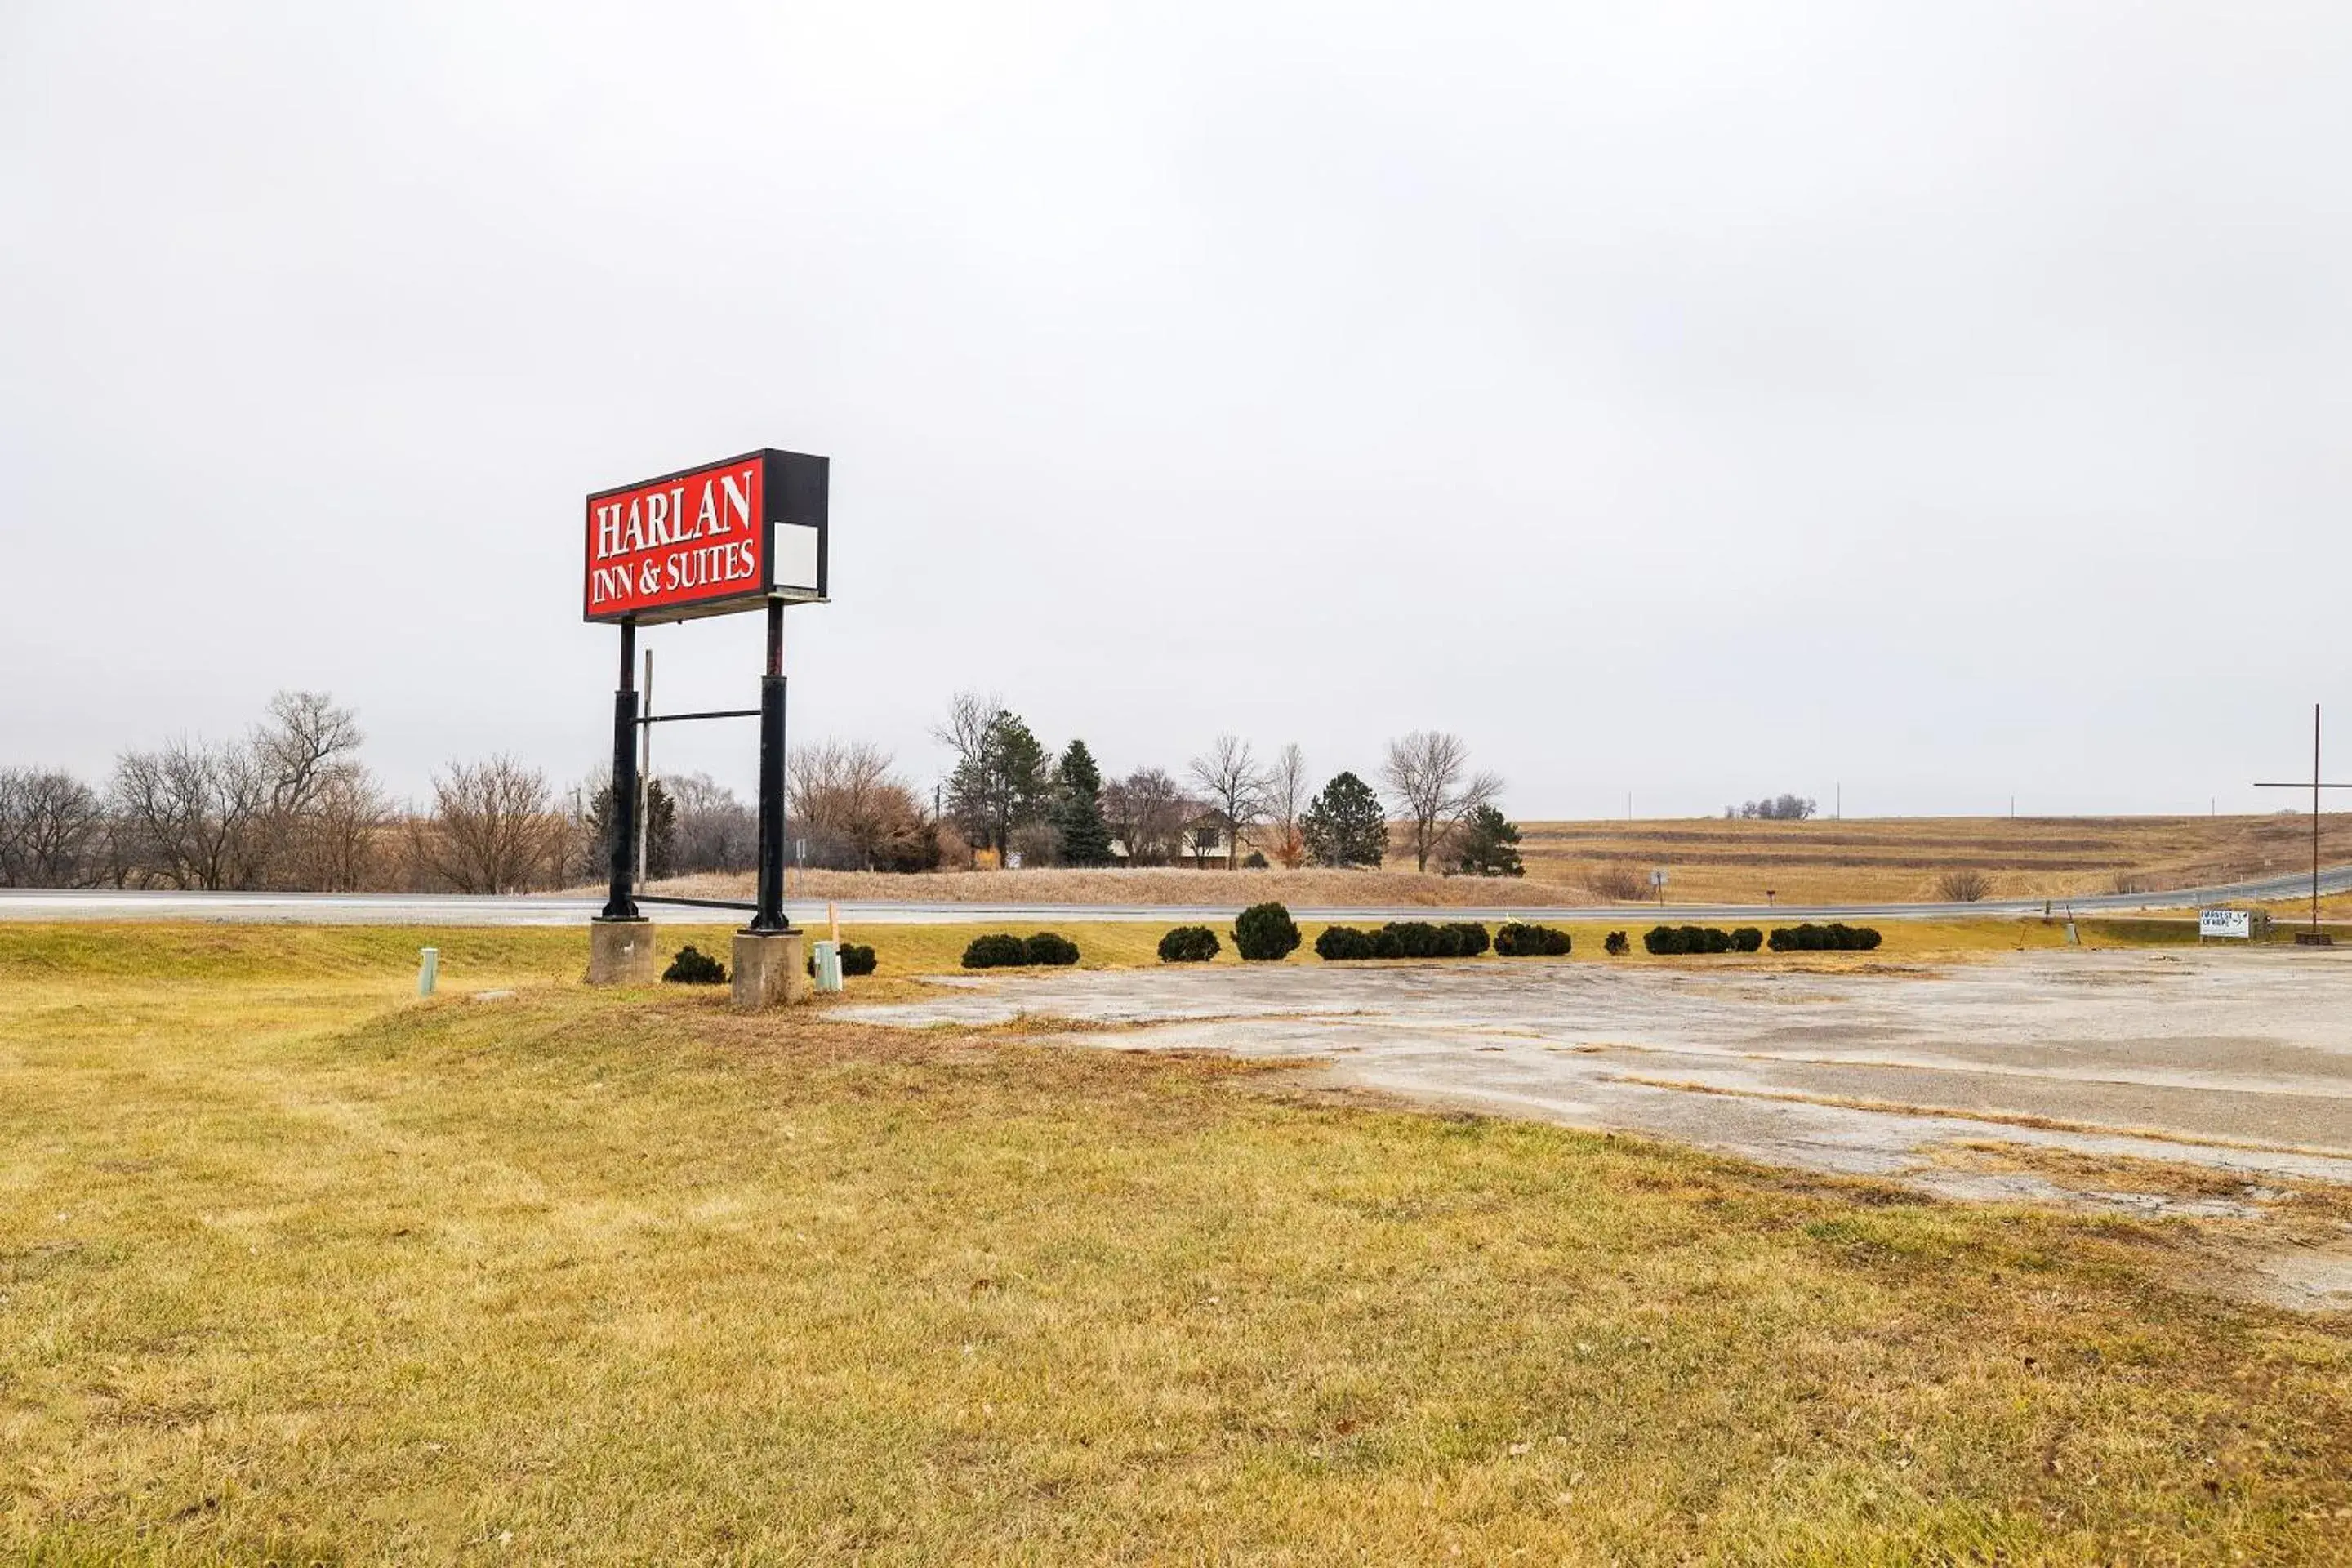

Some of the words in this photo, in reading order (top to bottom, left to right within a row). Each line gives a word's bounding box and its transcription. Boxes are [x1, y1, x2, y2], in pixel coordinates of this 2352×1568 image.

[596, 470, 753, 561] HARLAN
[592, 563, 634, 604] INN
[639, 559, 662, 595] &
[666, 539, 755, 591] SUITES
